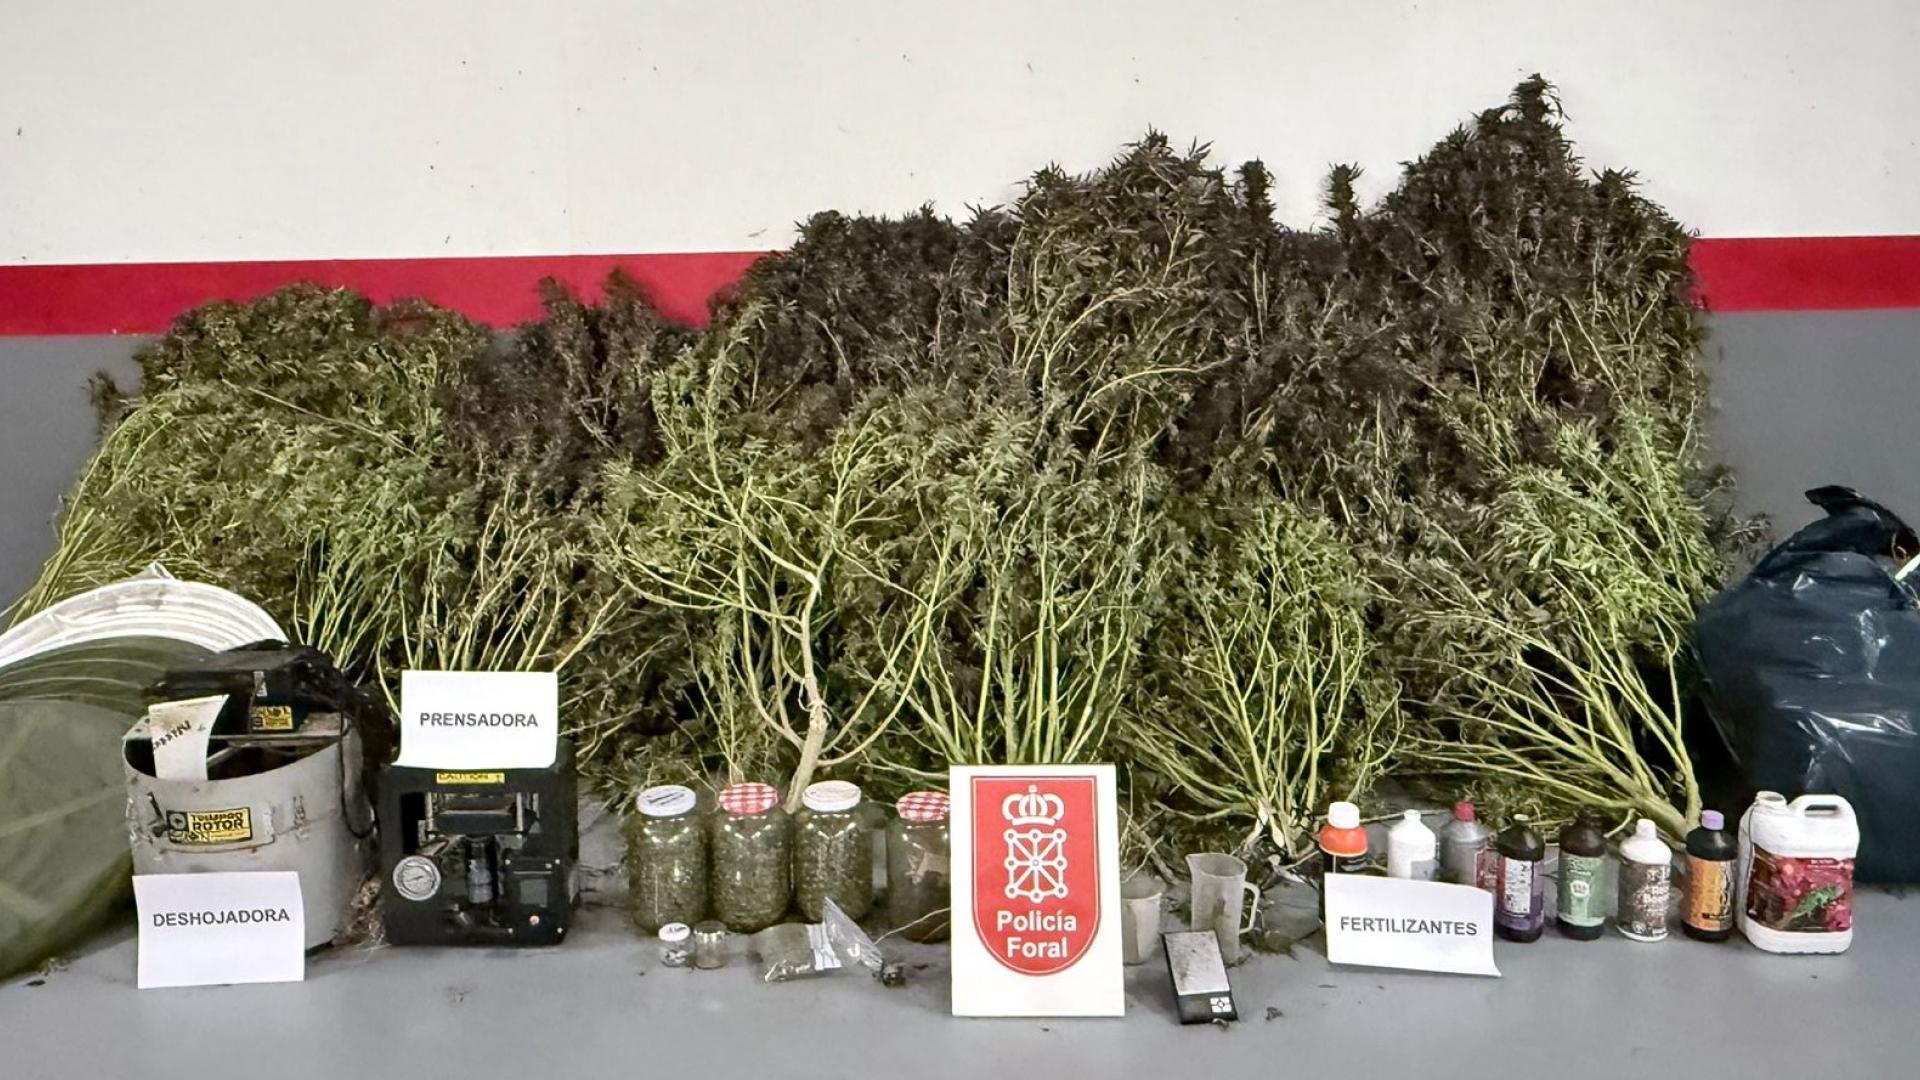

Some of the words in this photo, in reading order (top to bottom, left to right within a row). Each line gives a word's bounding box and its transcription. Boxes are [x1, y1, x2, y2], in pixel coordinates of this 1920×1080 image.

[420, 712, 538, 727] PRENSADORA
[193, 819, 244, 832] ROTOR
[153, 908, 290, 927] DESHOJADORA
[996, 909, 1077, 932] Policía
[1340, 917, 1478, 936] FERTILIZANTES
[1007, 937, 1069, 958] Foral
